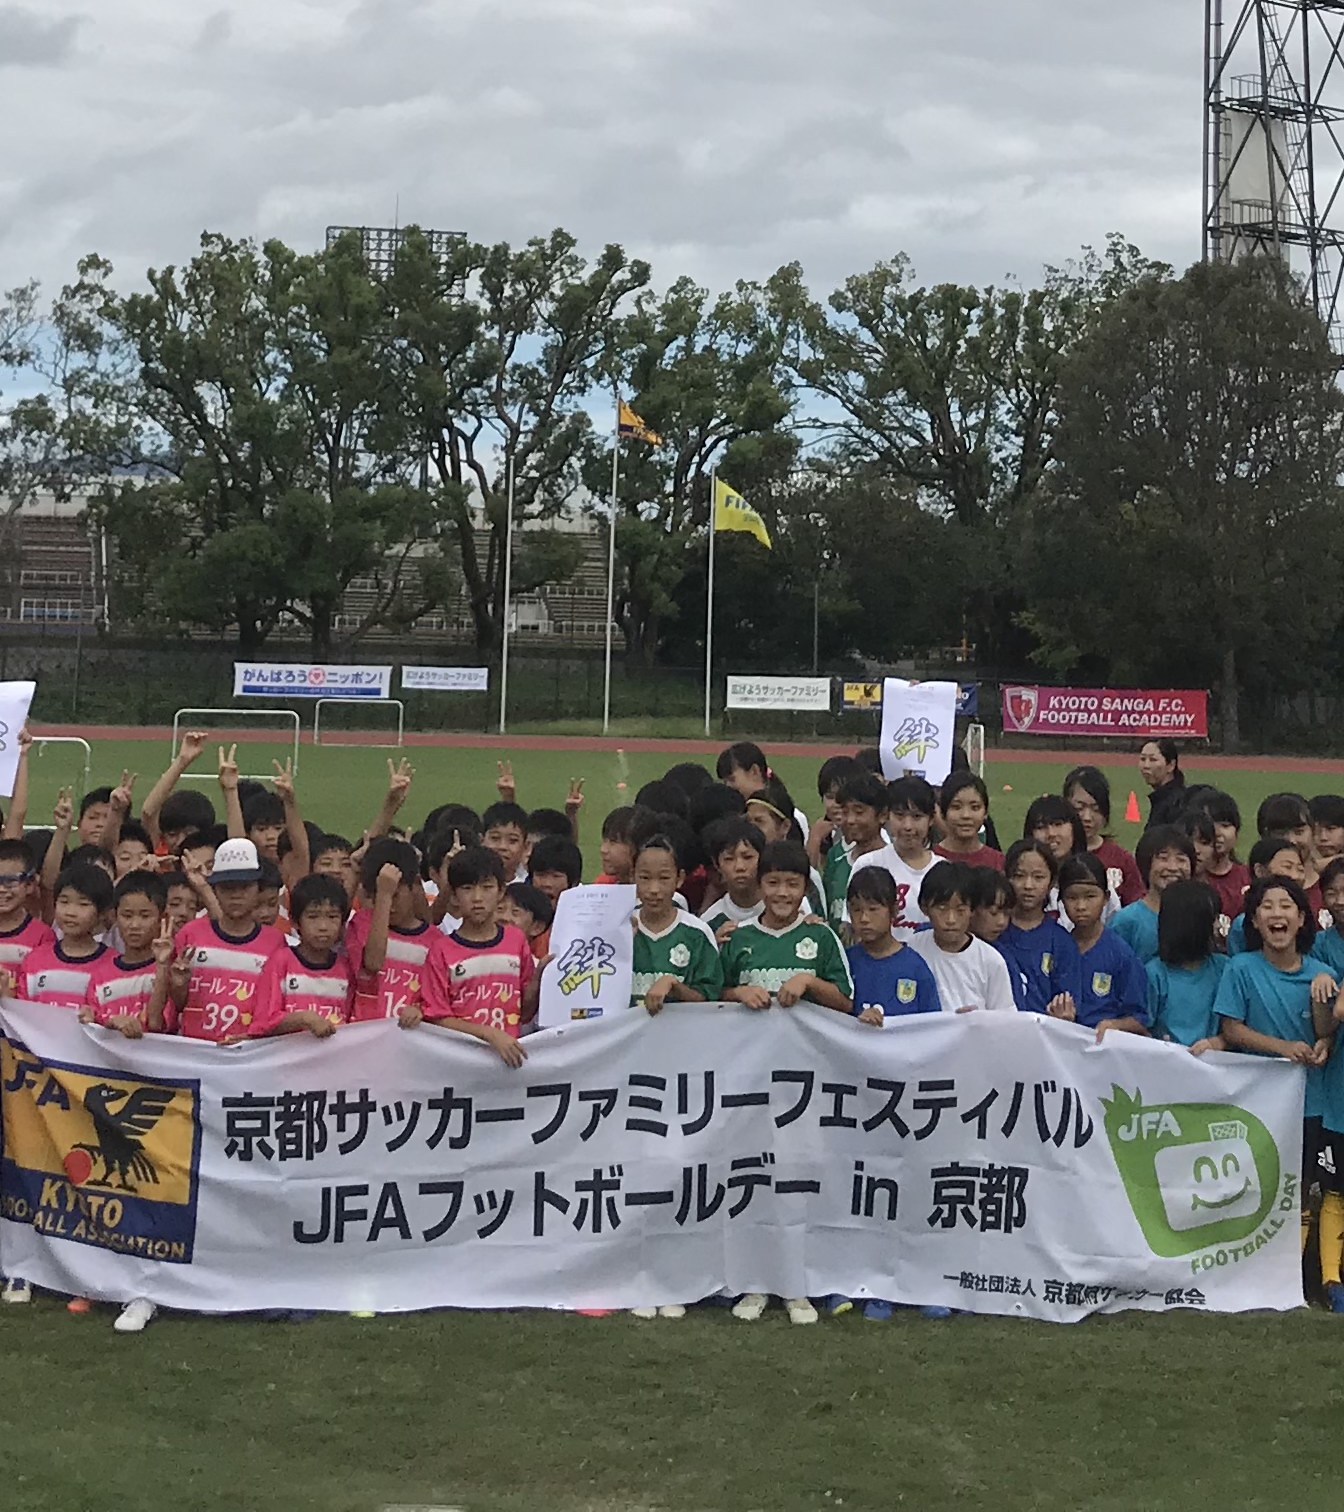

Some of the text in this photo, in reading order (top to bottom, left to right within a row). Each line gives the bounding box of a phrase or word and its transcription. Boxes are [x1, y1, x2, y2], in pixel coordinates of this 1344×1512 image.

[1039, 710, 1196, 727] FOOTBALL ACADEMY
[1048, 696, 1186, 712] KYOTO SANGA F.C.
[892, 717, 940, 764] 絆
[557, 936, 617, 999] 絆
[202, 1002, 240, 1033] 39
[221, 1070, 1094, 1162] 京都サッカーファミリーフェスティバル
[1118, 1109, 1182, 1142] JFA
[293, 1151, 1030, 1244] JFAフットボールデー in 京都
[1191, 1173, 1297, 1275] FOOTBALL DAY
[943, 1271, 1037, 1298] 一般社団法人
